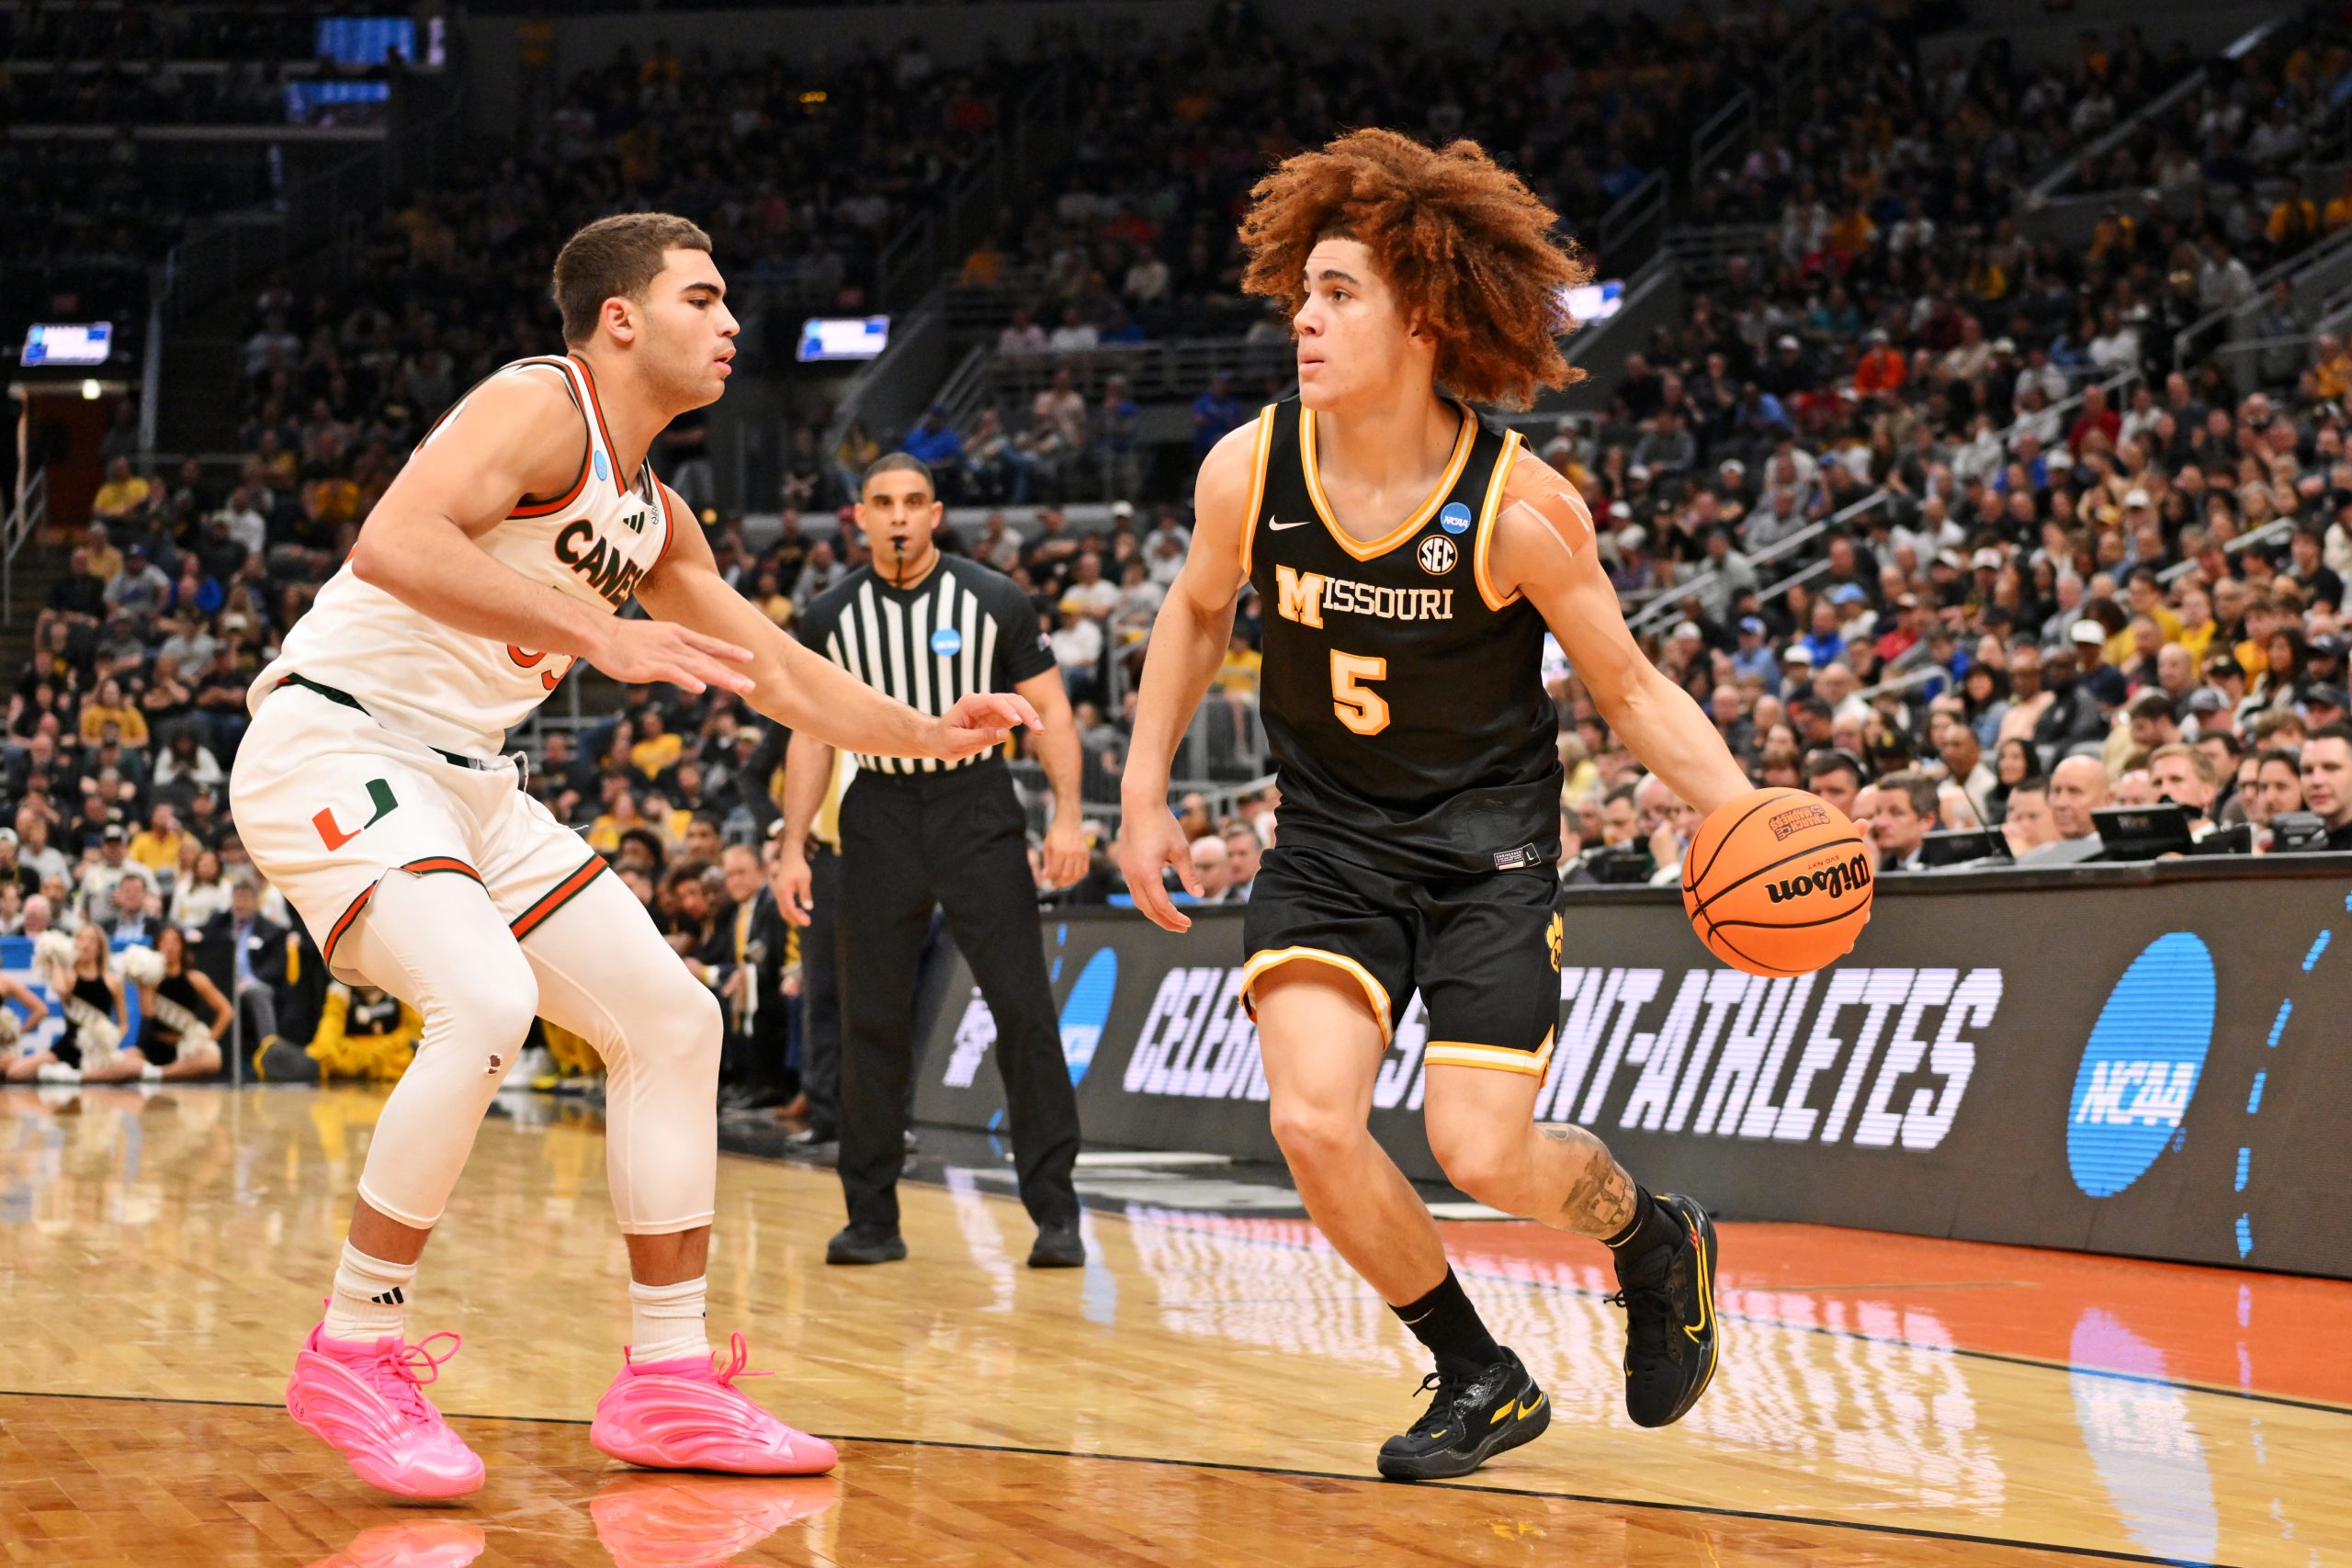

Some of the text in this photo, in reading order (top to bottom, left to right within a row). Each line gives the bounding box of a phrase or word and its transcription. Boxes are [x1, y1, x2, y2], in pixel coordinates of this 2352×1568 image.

[1443, 515, 1468, 528] NCAA
[554, 519, 644, 609] CANES
[1420, 537, 1454, 572] SEC
[1275, 563, 1454, 630] MISSOURI
[1329, 648, 1391, 736] 5
[1525, 851, 1534, 862] L
[1764, 852, 1871, 904] Wilson
[2075, 1060, 2196, 1128] NCAA
